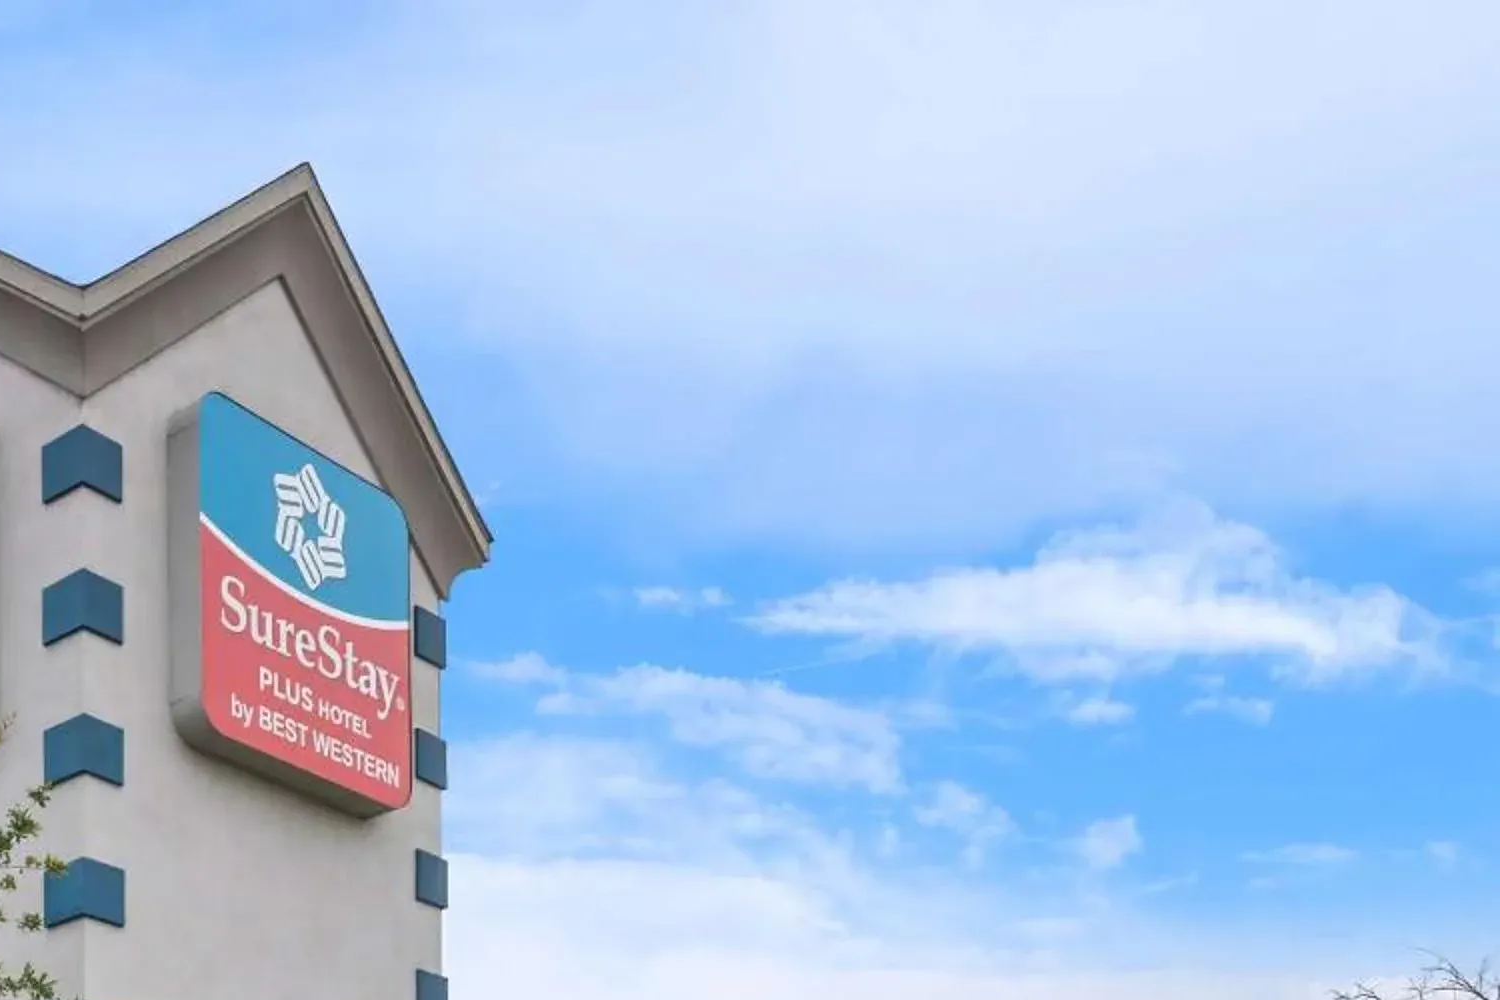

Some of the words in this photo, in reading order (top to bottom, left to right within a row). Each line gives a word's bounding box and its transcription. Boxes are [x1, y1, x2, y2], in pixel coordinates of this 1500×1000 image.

[220, 575, 397, 719] SureStay
[230, 691, 253, 728] by
[258, 705, 308, 748] BEST
[312, 729, 400, 788] WESTERN
[258, 666, 313, 711] PLUS
[318, 697, 372, 738] HOTEL
